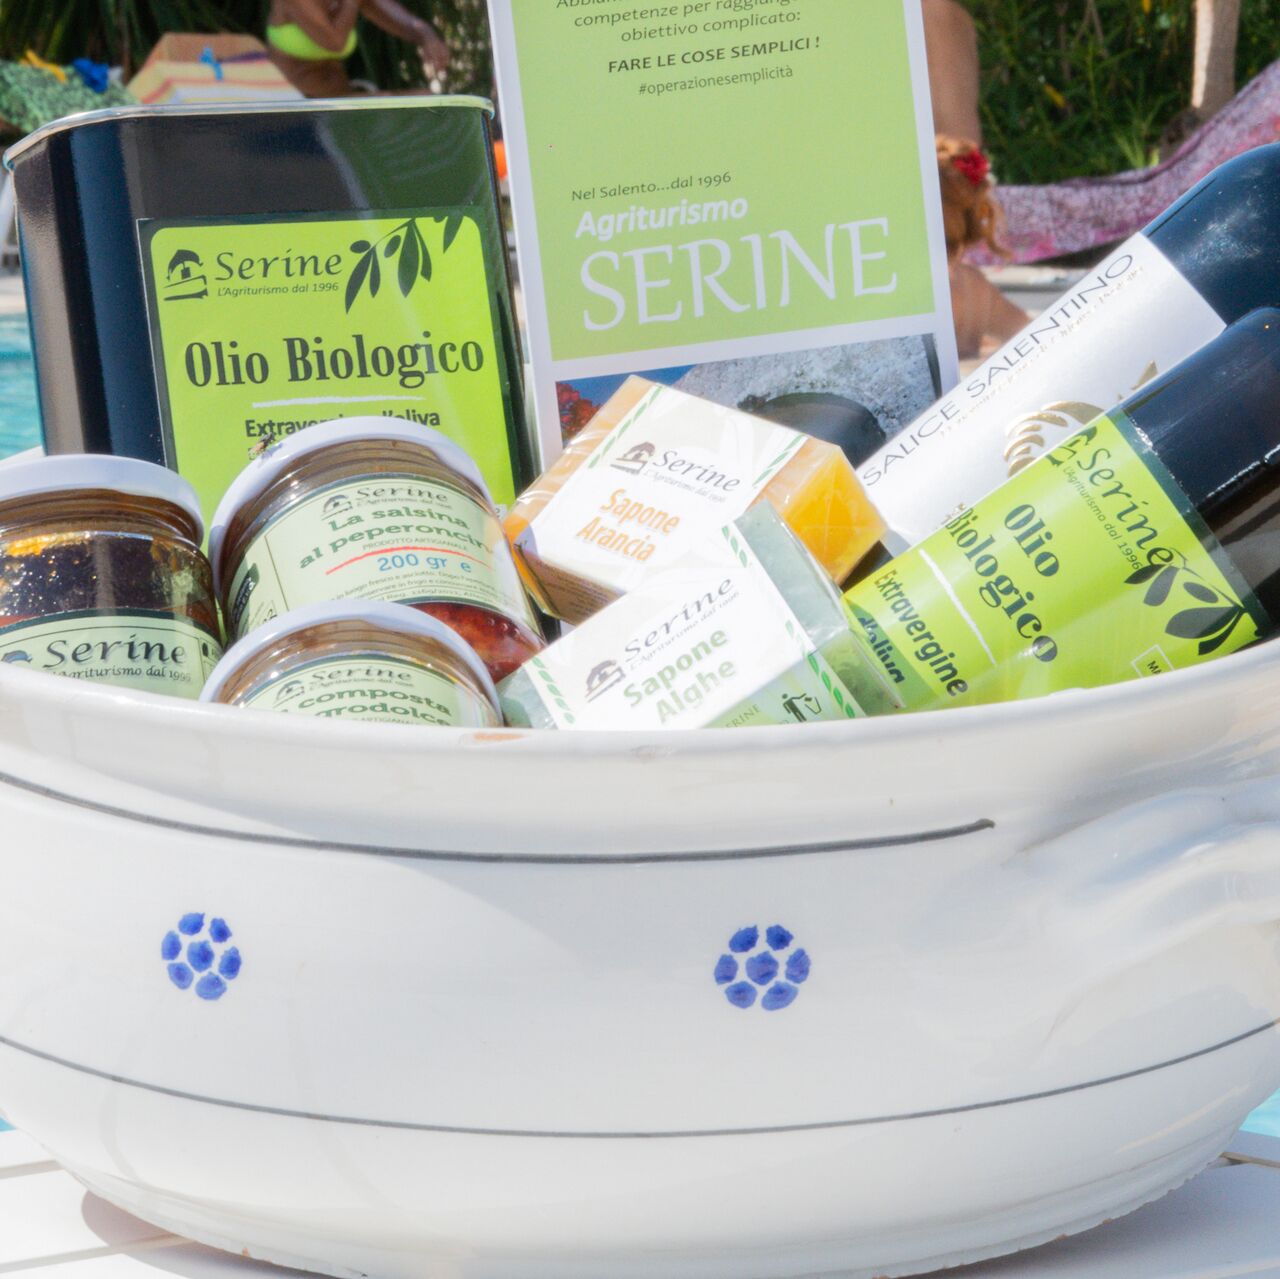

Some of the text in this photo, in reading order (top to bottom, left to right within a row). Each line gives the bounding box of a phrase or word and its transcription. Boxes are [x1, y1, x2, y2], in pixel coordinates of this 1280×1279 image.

[573, 5, 679, 27] competenze
[682, 0, 712, 18] per
[620, 11, 801, 42] obiettivo complicato:
[608, 56, 652, 73] FARE
[656, 53, 677, 68] LE
[680, 48, 726, 65] COSE
[730, 37, 811, 59] SEMPLICI
[638, 64, 793, 97] #operazionesemplicità
[571, 187, 596, 201] Nel
[697, 171, 732, 189] 1996
[575, 196, 749, 242] Agriturismo
[214, 248, 343, 281] Serine
[579, 216, 898, 332] SERINE
[291, 283, 309, 294] dal
[312, 281, 339, 293] 1996
[184, 329, 485, 389] Olio Biologico
[862, 400, 961, 487] SALICE
[966, 254, 1133, 399] SALENTINO
[652, 450, 741, 492] Serine
[328, 514, 365, 532] La
[371, 506, 471, 530] salsina
[599, 488, 681, 534] Sapone
[1076, 446, 1175, 567] Serine
[299, 523, 494, 569] al peperoncin
[362, 537, 413, 551] PRODOTTO
[575, 516, 657, 562] Arancia
[1004, 503, 1060, 577] Olio
[1103, 522, 1122, 543] dal
[1117, 540, 1143, 571] 1996
[376, 552, 420, 572] 200
[425, 556, 448, 570] gr
[942, 507, 1058, 663] Biologico
[42, 633, 187, 669] Serine
[873, 569, 969, 697] Extravergine
[146, 664, 166, 678] dal
[623, 630, 729, 708] Sapone
[298, 688, 453, 718] composta
[656, 660, 737, 724] Alghe
